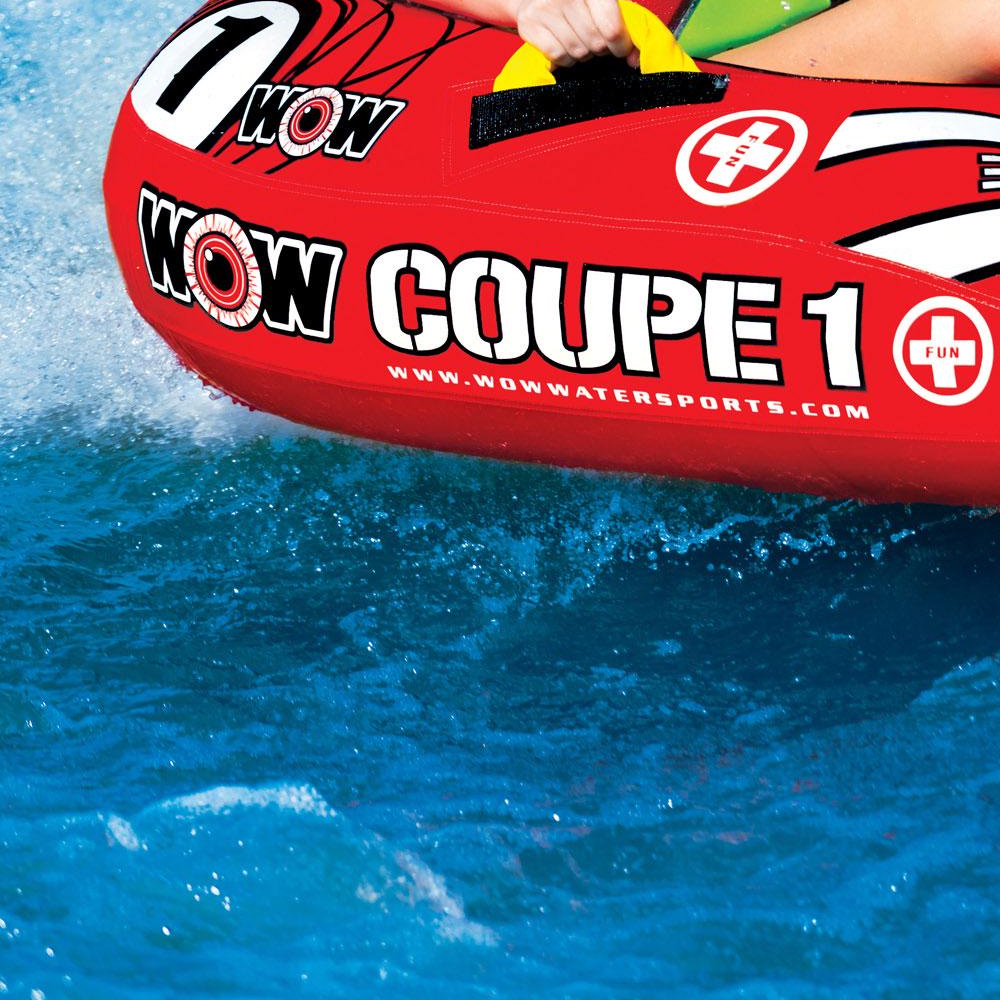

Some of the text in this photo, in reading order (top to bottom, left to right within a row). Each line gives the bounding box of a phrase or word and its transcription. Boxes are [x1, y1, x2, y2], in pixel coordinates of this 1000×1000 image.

[155, 14, 274, 116] 1
[236, 83, 407, 160] WOW
[725, 134, 760, 168] FUN
[136, 183, 346, 344] WOW
[367, 243, 866, 391] COUPE 1
[925, 345, 960, 359] FUN
[386, 364, 871, 421] WWW.WOWWATERSPORTS.COM
